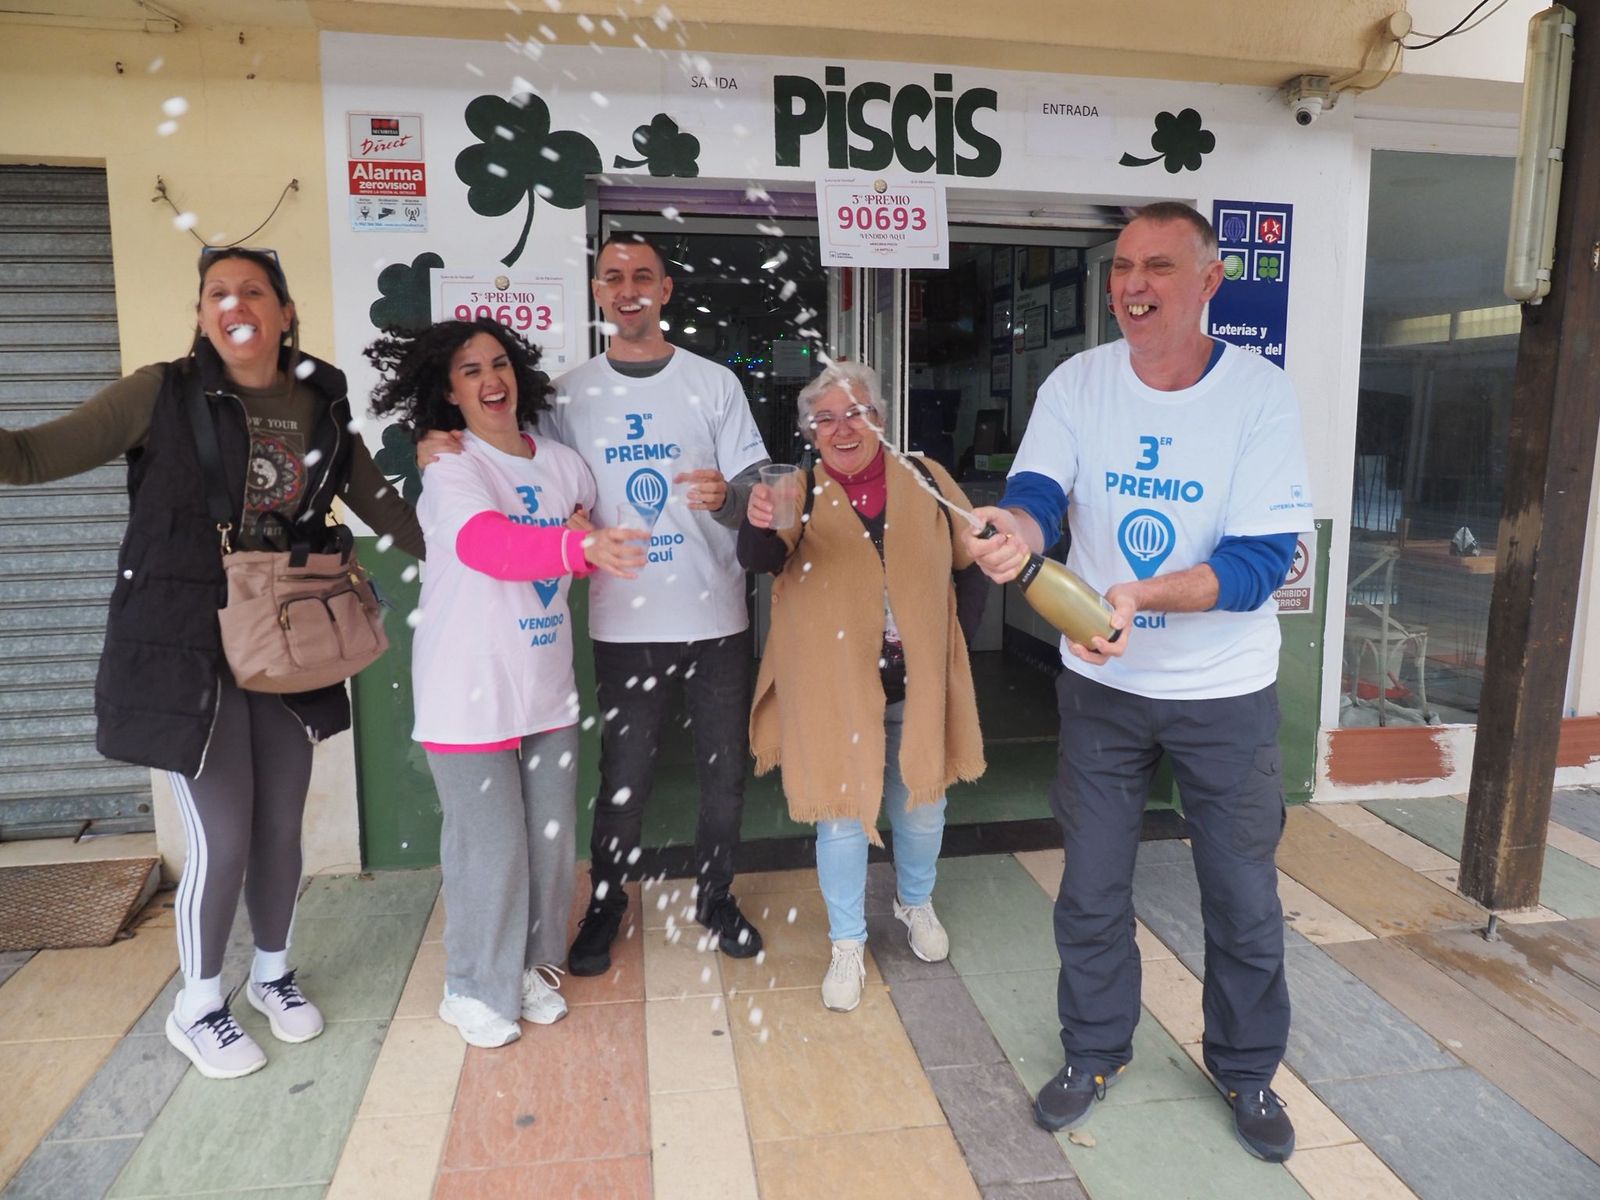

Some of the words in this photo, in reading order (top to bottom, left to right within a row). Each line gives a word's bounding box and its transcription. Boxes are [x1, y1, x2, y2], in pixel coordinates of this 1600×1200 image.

[691, 75, 738, 90] SAIDA
[1043, 103, 1099, 117] ENTRADA
[360, 135, 413, 155] Direct
[352, 163, 423, 181] Alarma
[359, 181, 417, 190] zerovision
[865, 194, 911, 206] PREMIO
[838, 206, 927, 231] 90693
[485, 292, 535, 303] PREMIO
[1212, 323, 1258, 336] Loterías
[1260, 327, 1268, 340] y
[1265, 342, 1283, 356] del
[268, 418, 298, 430] YOUR
[605, 443, 681, 464] PREMIO
[1136, 436, 1173, 471] 3ER
[1105, 471, 1204, 504] PREMIO
[649, 533, 684, 547] DIDO
[648, 547, 673, 562] QUÍ
[519, 614, 564, 631] VENDIDO
[1133, 612, 1167, 629] QUÍ
[531, 631, 557, 648] AQUÍ
